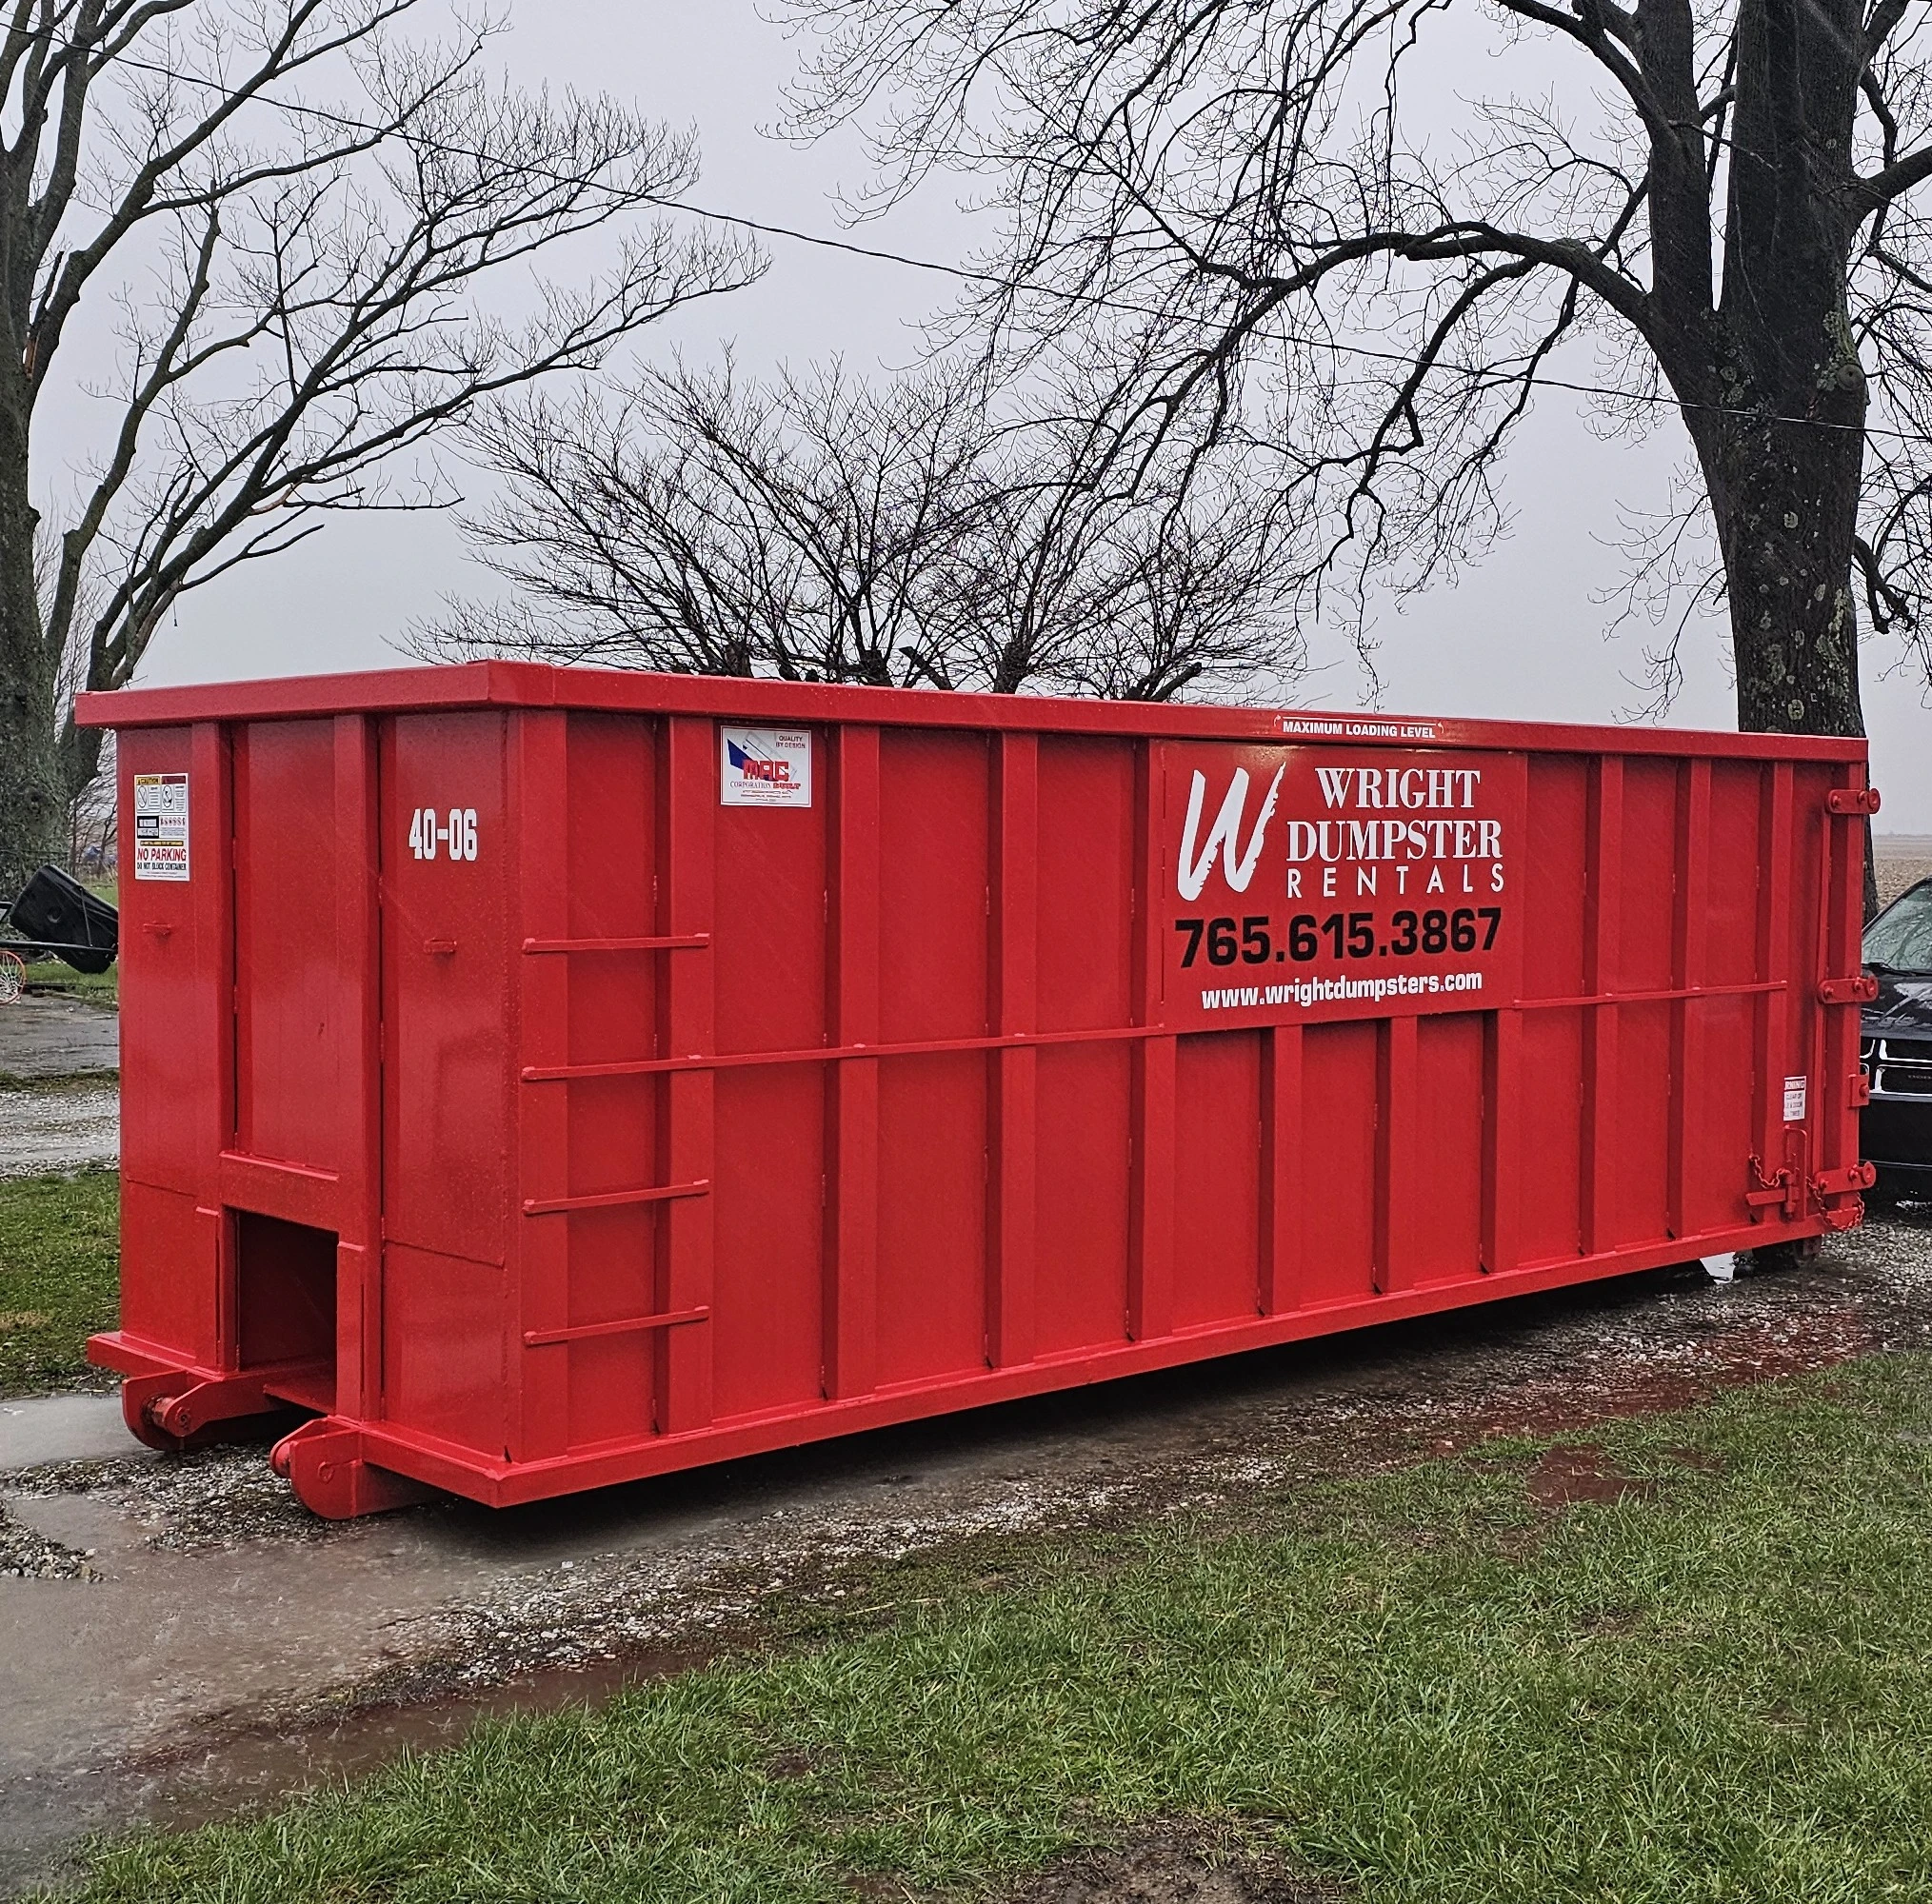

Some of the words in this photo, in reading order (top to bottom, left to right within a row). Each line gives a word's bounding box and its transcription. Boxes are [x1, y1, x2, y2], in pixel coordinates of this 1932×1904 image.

[1283, 721, 1343, 735] MAXIMUM
[1345, 724, 1398, 737] LOADING
[1400, 725, 1436, 739] LEVEL
[743, 759, 789, 781] MAC
[1314, 767, 1481, 809] WRIGHT
[408, 808, 478, 862] 40-06
[1177, 762, 1286, 901] W
[1286, 819, 1503, 862] DUMPSTER
[137, 847, 149, 861] NO
[150, 848, 186, 862] PARKING
[1286, 863, 1504, 899] RENTALS
[1174, 906, 1502, 969] 765.615.3867
[1201, 971, 1483, 1010] www.wrightdumpsters.com
